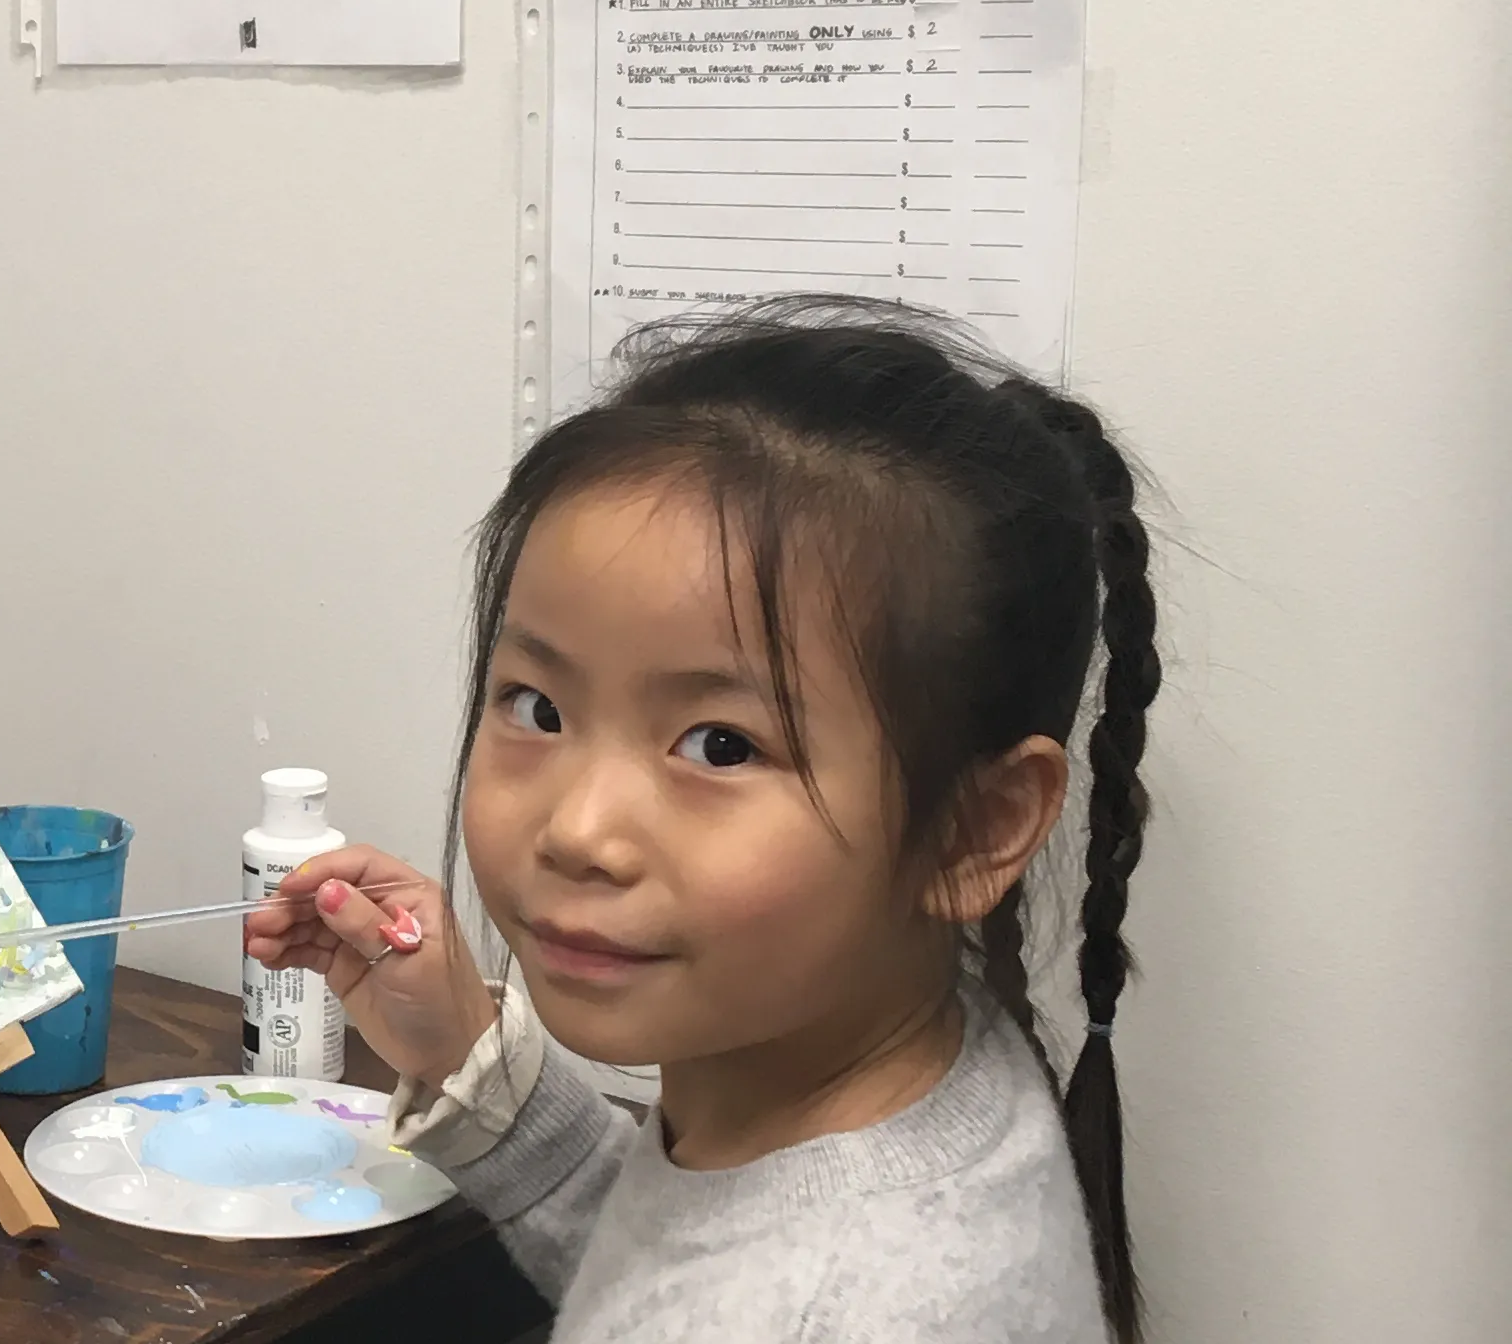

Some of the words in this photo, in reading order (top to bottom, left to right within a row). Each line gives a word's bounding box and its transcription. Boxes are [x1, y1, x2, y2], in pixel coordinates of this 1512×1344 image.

[660, 0, 670, 8] IN
[629, 32, 682, 43] COMPLETE
[689, 32, 696, 41] A
[809, 25, 854, 39] ONLY
[862, 28, 893, 38] USING
[927, 22, 937, 36] 2
